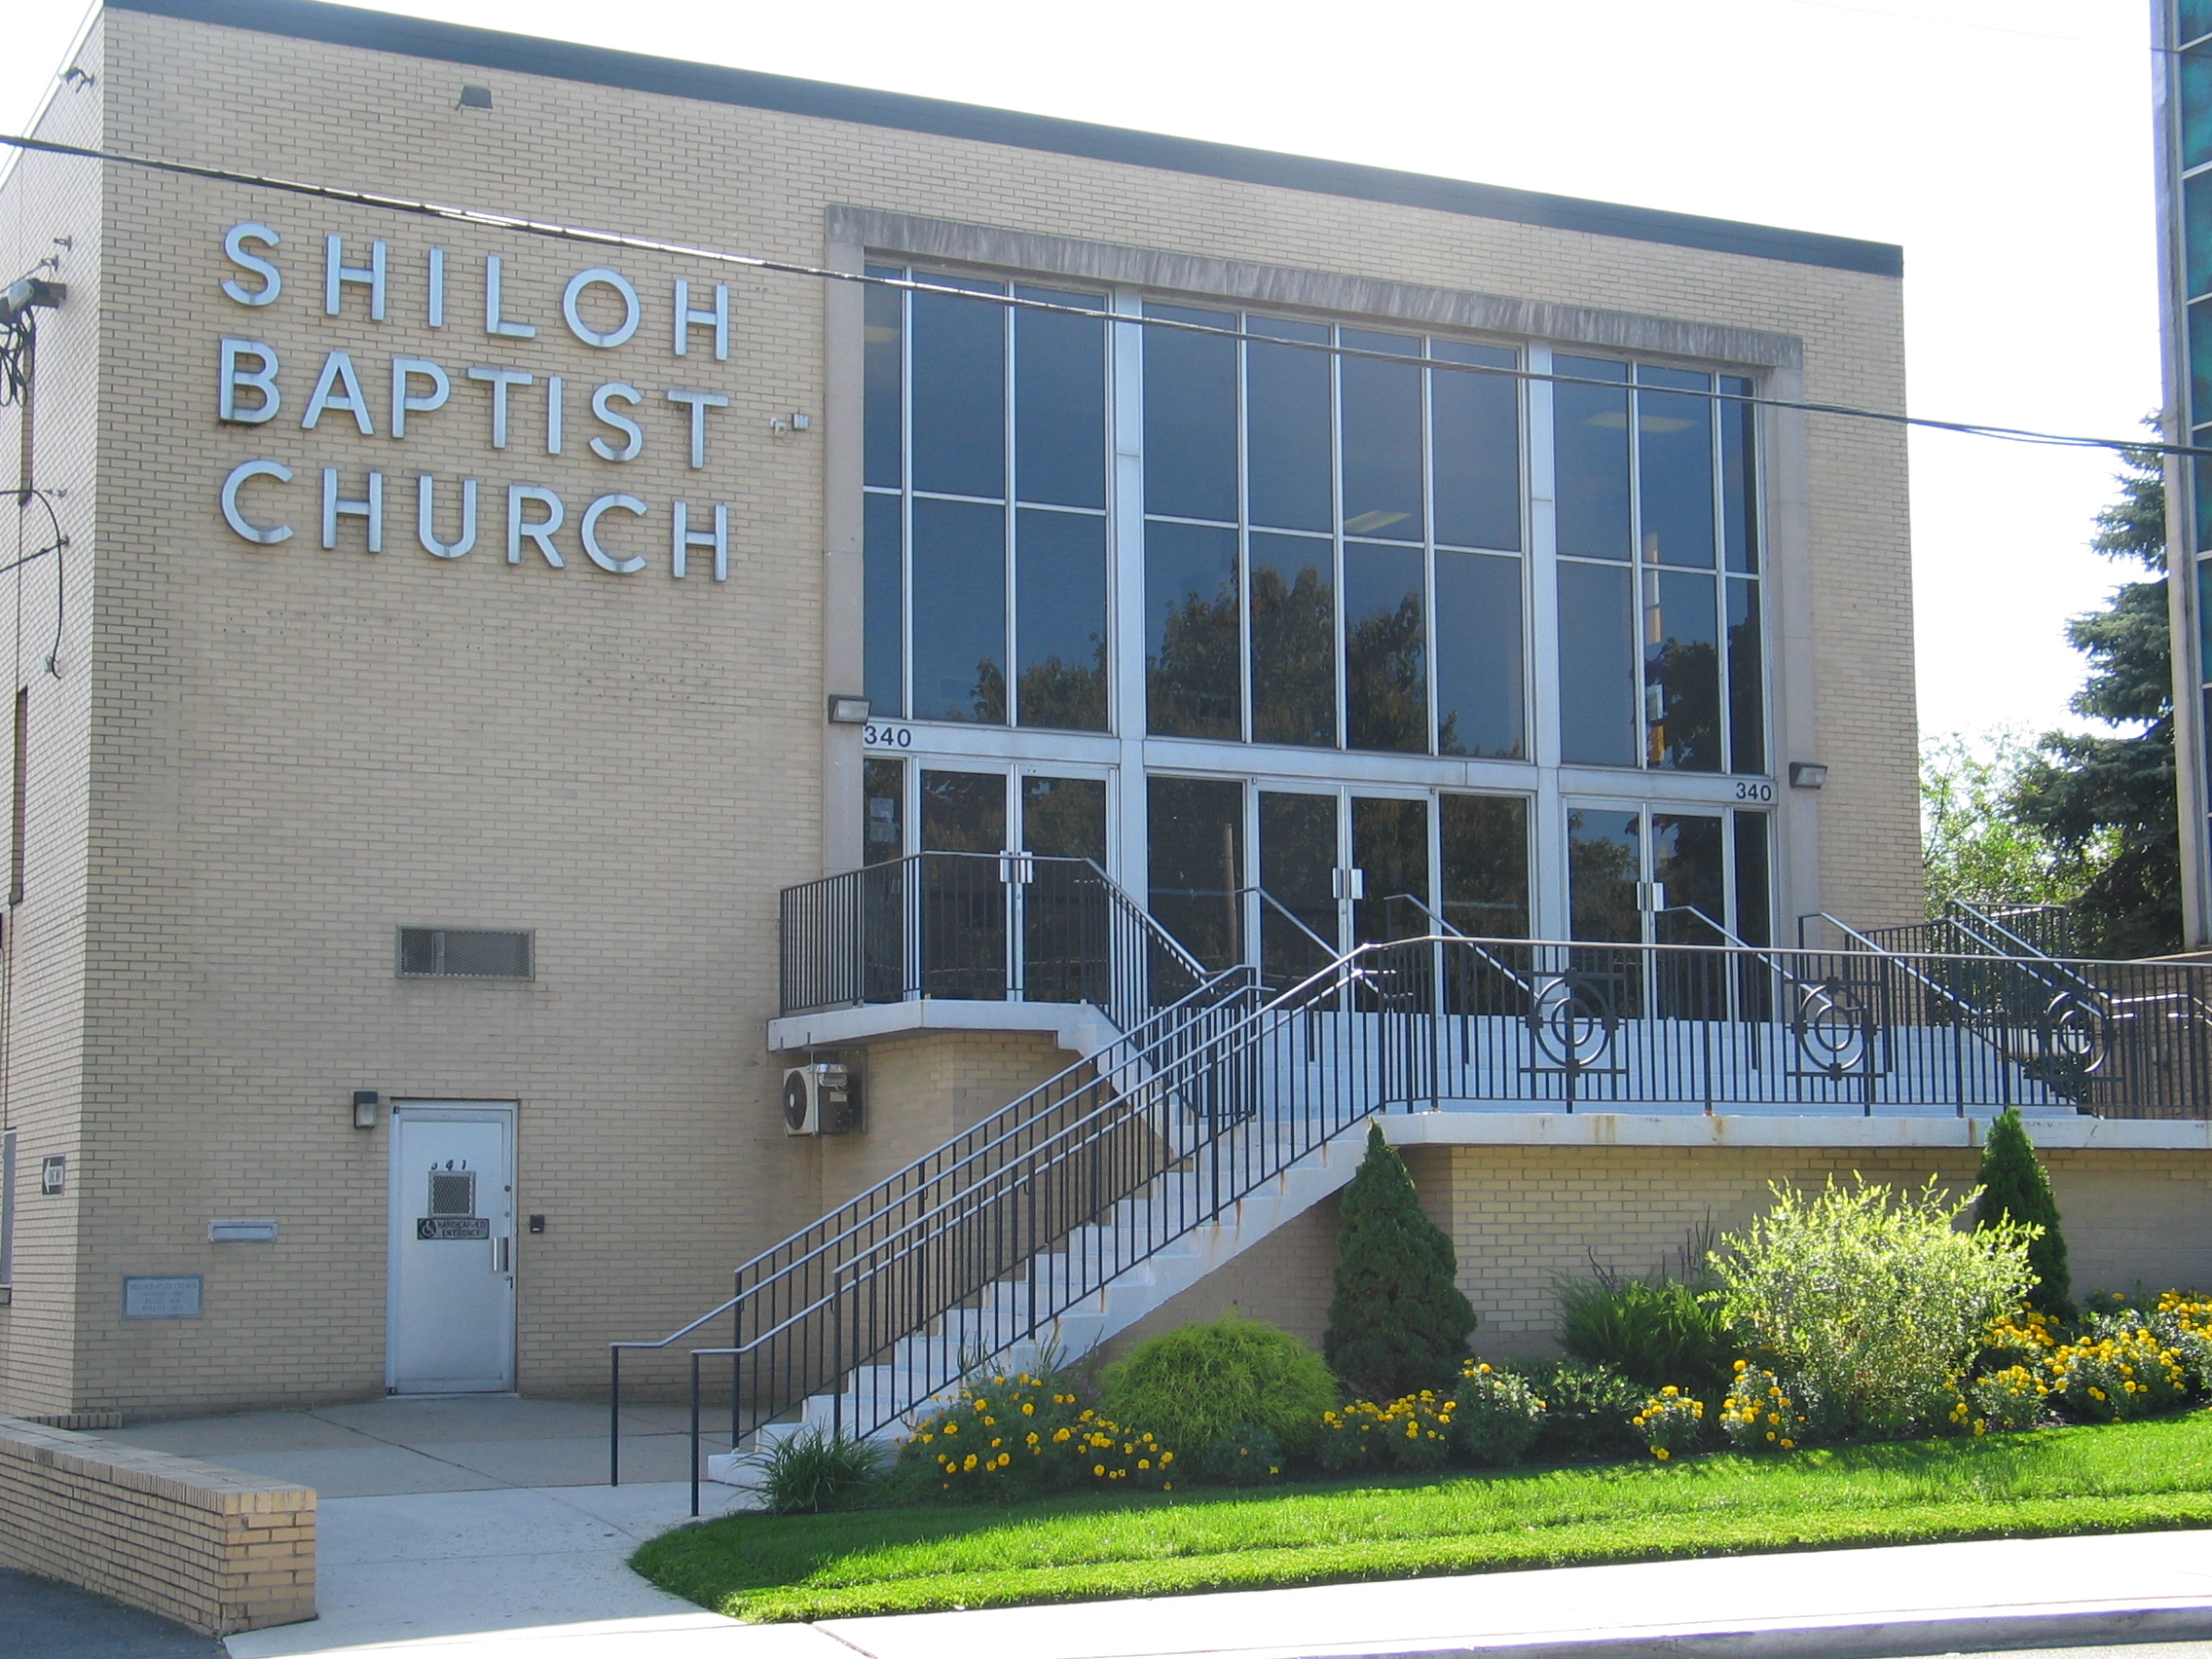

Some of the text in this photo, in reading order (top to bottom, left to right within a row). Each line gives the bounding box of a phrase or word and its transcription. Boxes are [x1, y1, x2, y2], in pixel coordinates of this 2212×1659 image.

[220, 222, 728, 362] SHILOH
[219, 338, 729, 470] BAPTIST
[220, 460, 729, 582] CHURCH
[864, 724, 911, 748] 340
[1736, 782, 1772, 801] 340
